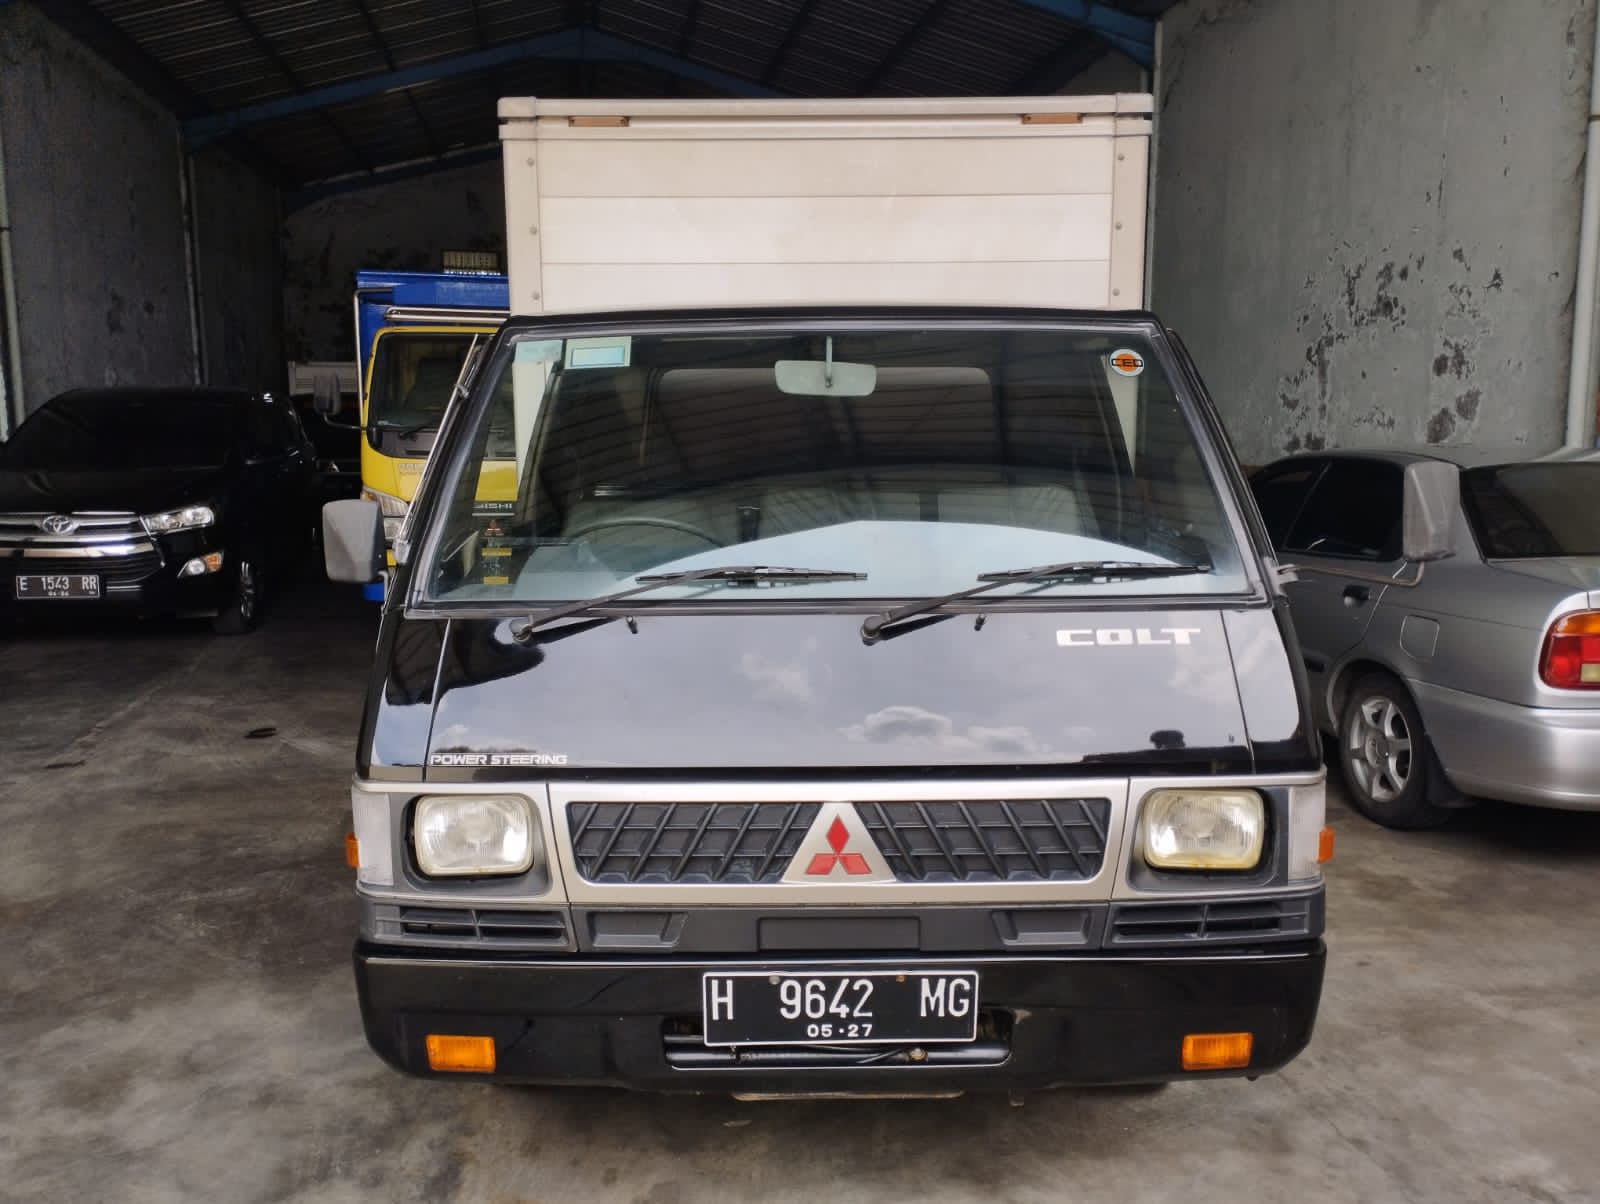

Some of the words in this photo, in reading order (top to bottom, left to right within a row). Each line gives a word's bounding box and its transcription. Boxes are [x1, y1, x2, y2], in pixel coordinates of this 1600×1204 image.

[20, 577, 28, 591] E
[41, 576, 70, 590] 1543
[82, 576, 97, 590] RR
[1056, 628, 1201, 646] COLT
[431, 754, 487, 765] POWER
[490, 754, 568, 765] STEERING
[711, 979, 734, 1020] H
[780, 979, 874, 1019] 9642
[920, 978, 971, 1017] MG
